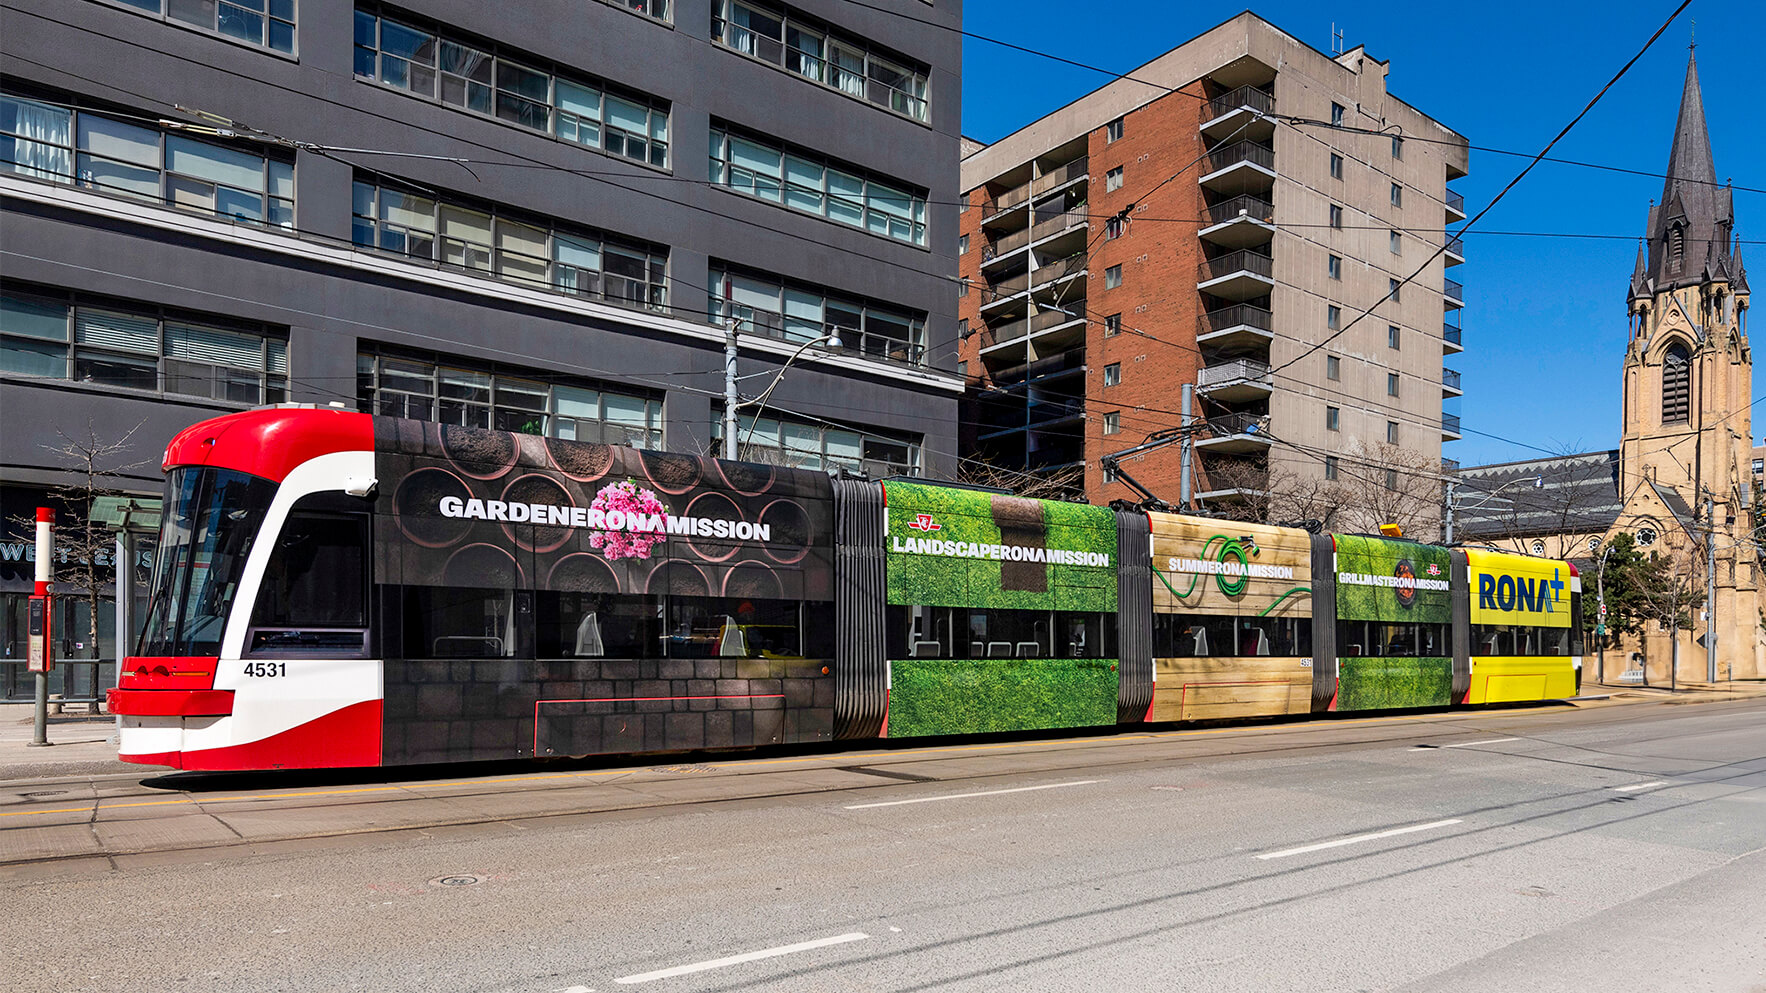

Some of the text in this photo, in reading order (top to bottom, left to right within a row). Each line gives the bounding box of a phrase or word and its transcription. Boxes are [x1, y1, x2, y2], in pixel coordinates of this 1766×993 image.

[439, 496, 771, 541] GARDENERONAMISSION
[893, 536, 1109, 567] LANDSCAPERONAMISSION
[1168, 558, 1293, 579] SUMMERONAMISSION
[1339, 572, 1449, 591] GRILLMASTERONAMISSION
[244, 662, 286, 677] 4531
